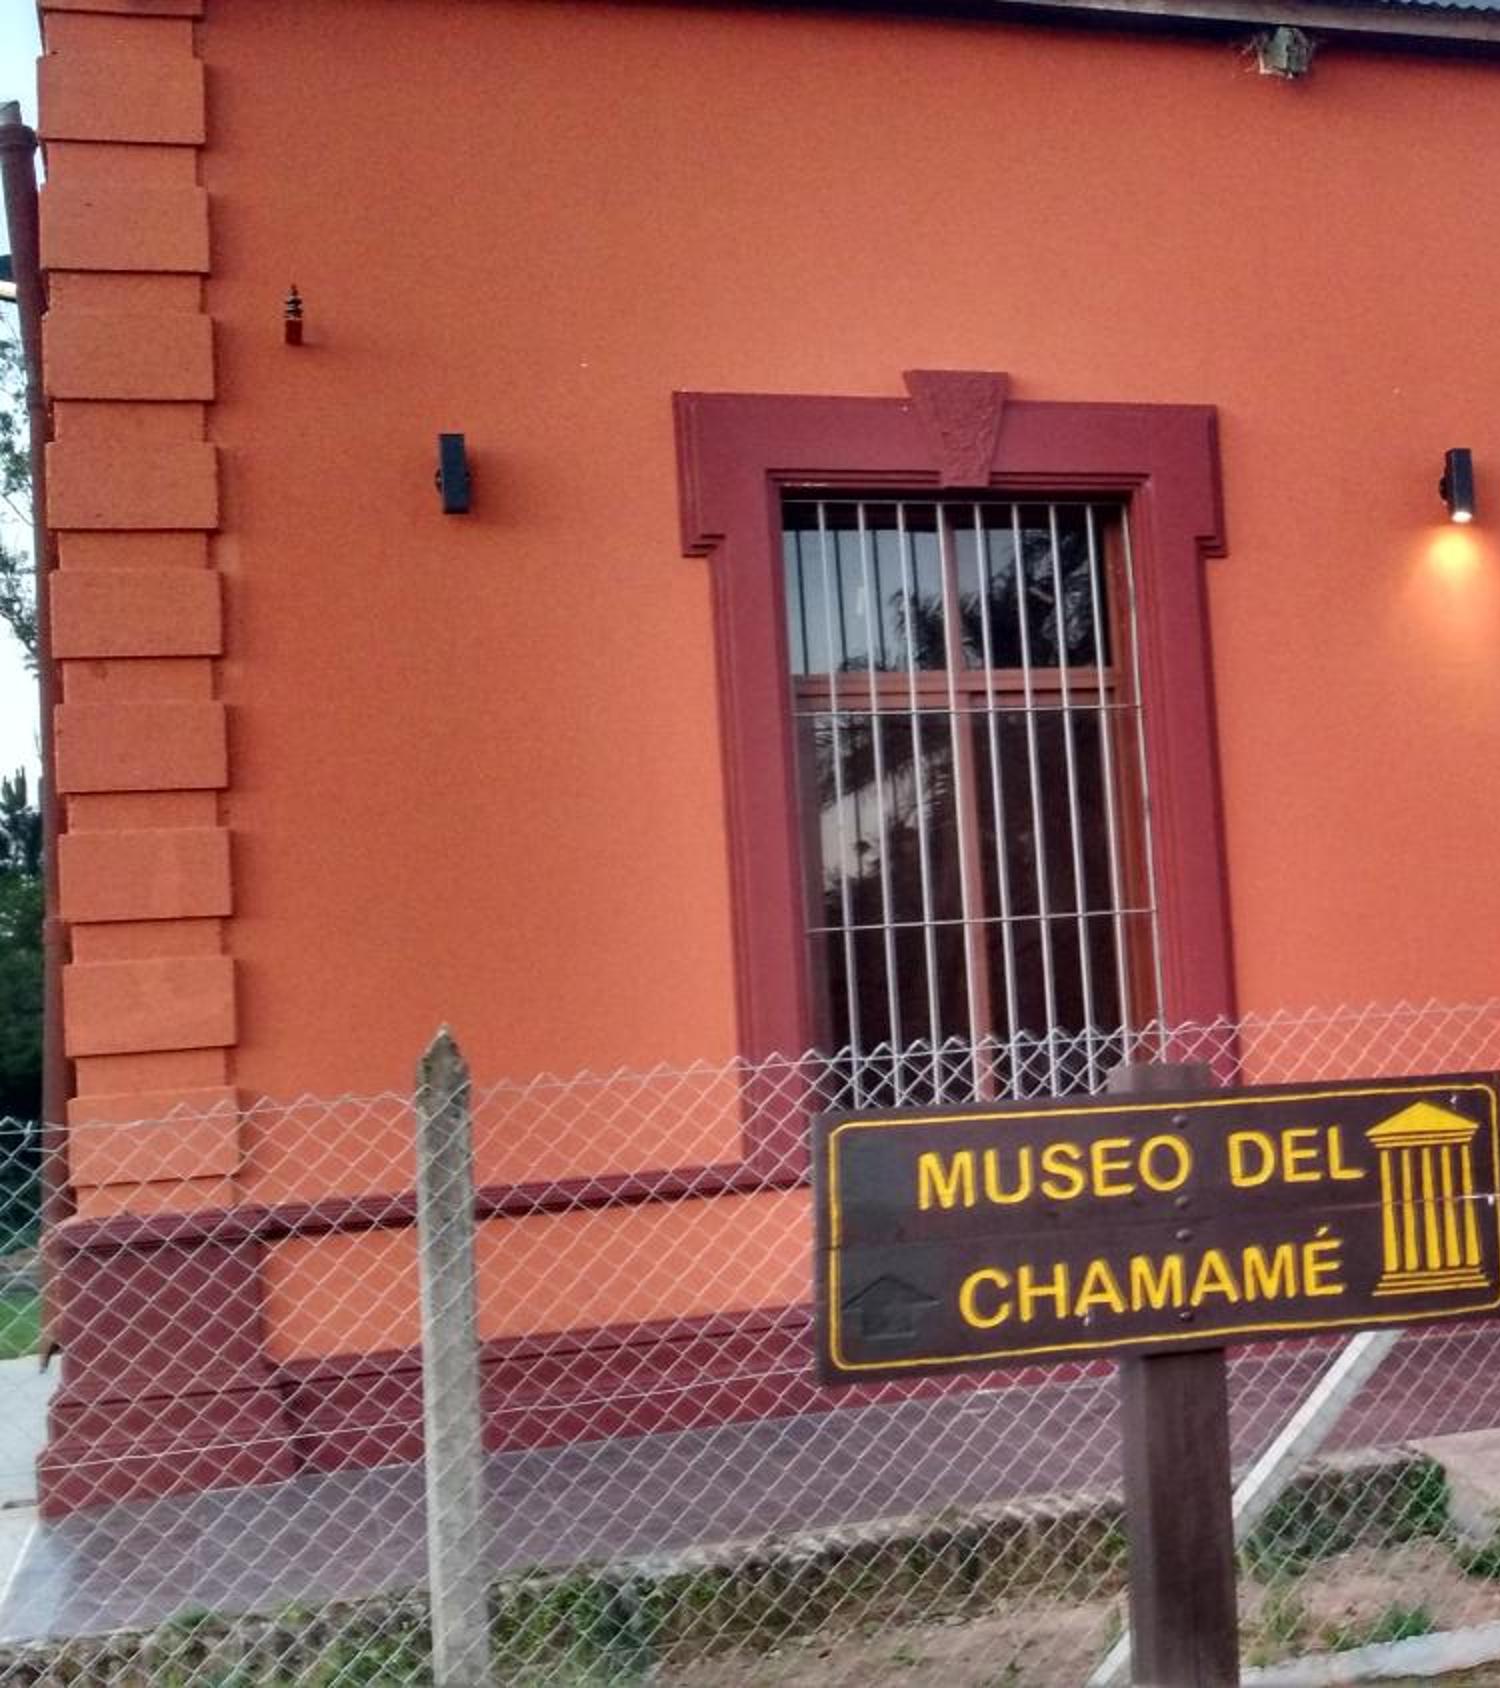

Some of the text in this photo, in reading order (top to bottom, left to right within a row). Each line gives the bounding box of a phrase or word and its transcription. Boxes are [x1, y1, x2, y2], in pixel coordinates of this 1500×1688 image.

[917, 1126, 1364, 1209] MUSEO DEL
[959, 1225, 1345, 1328] CHAMAMÉ
